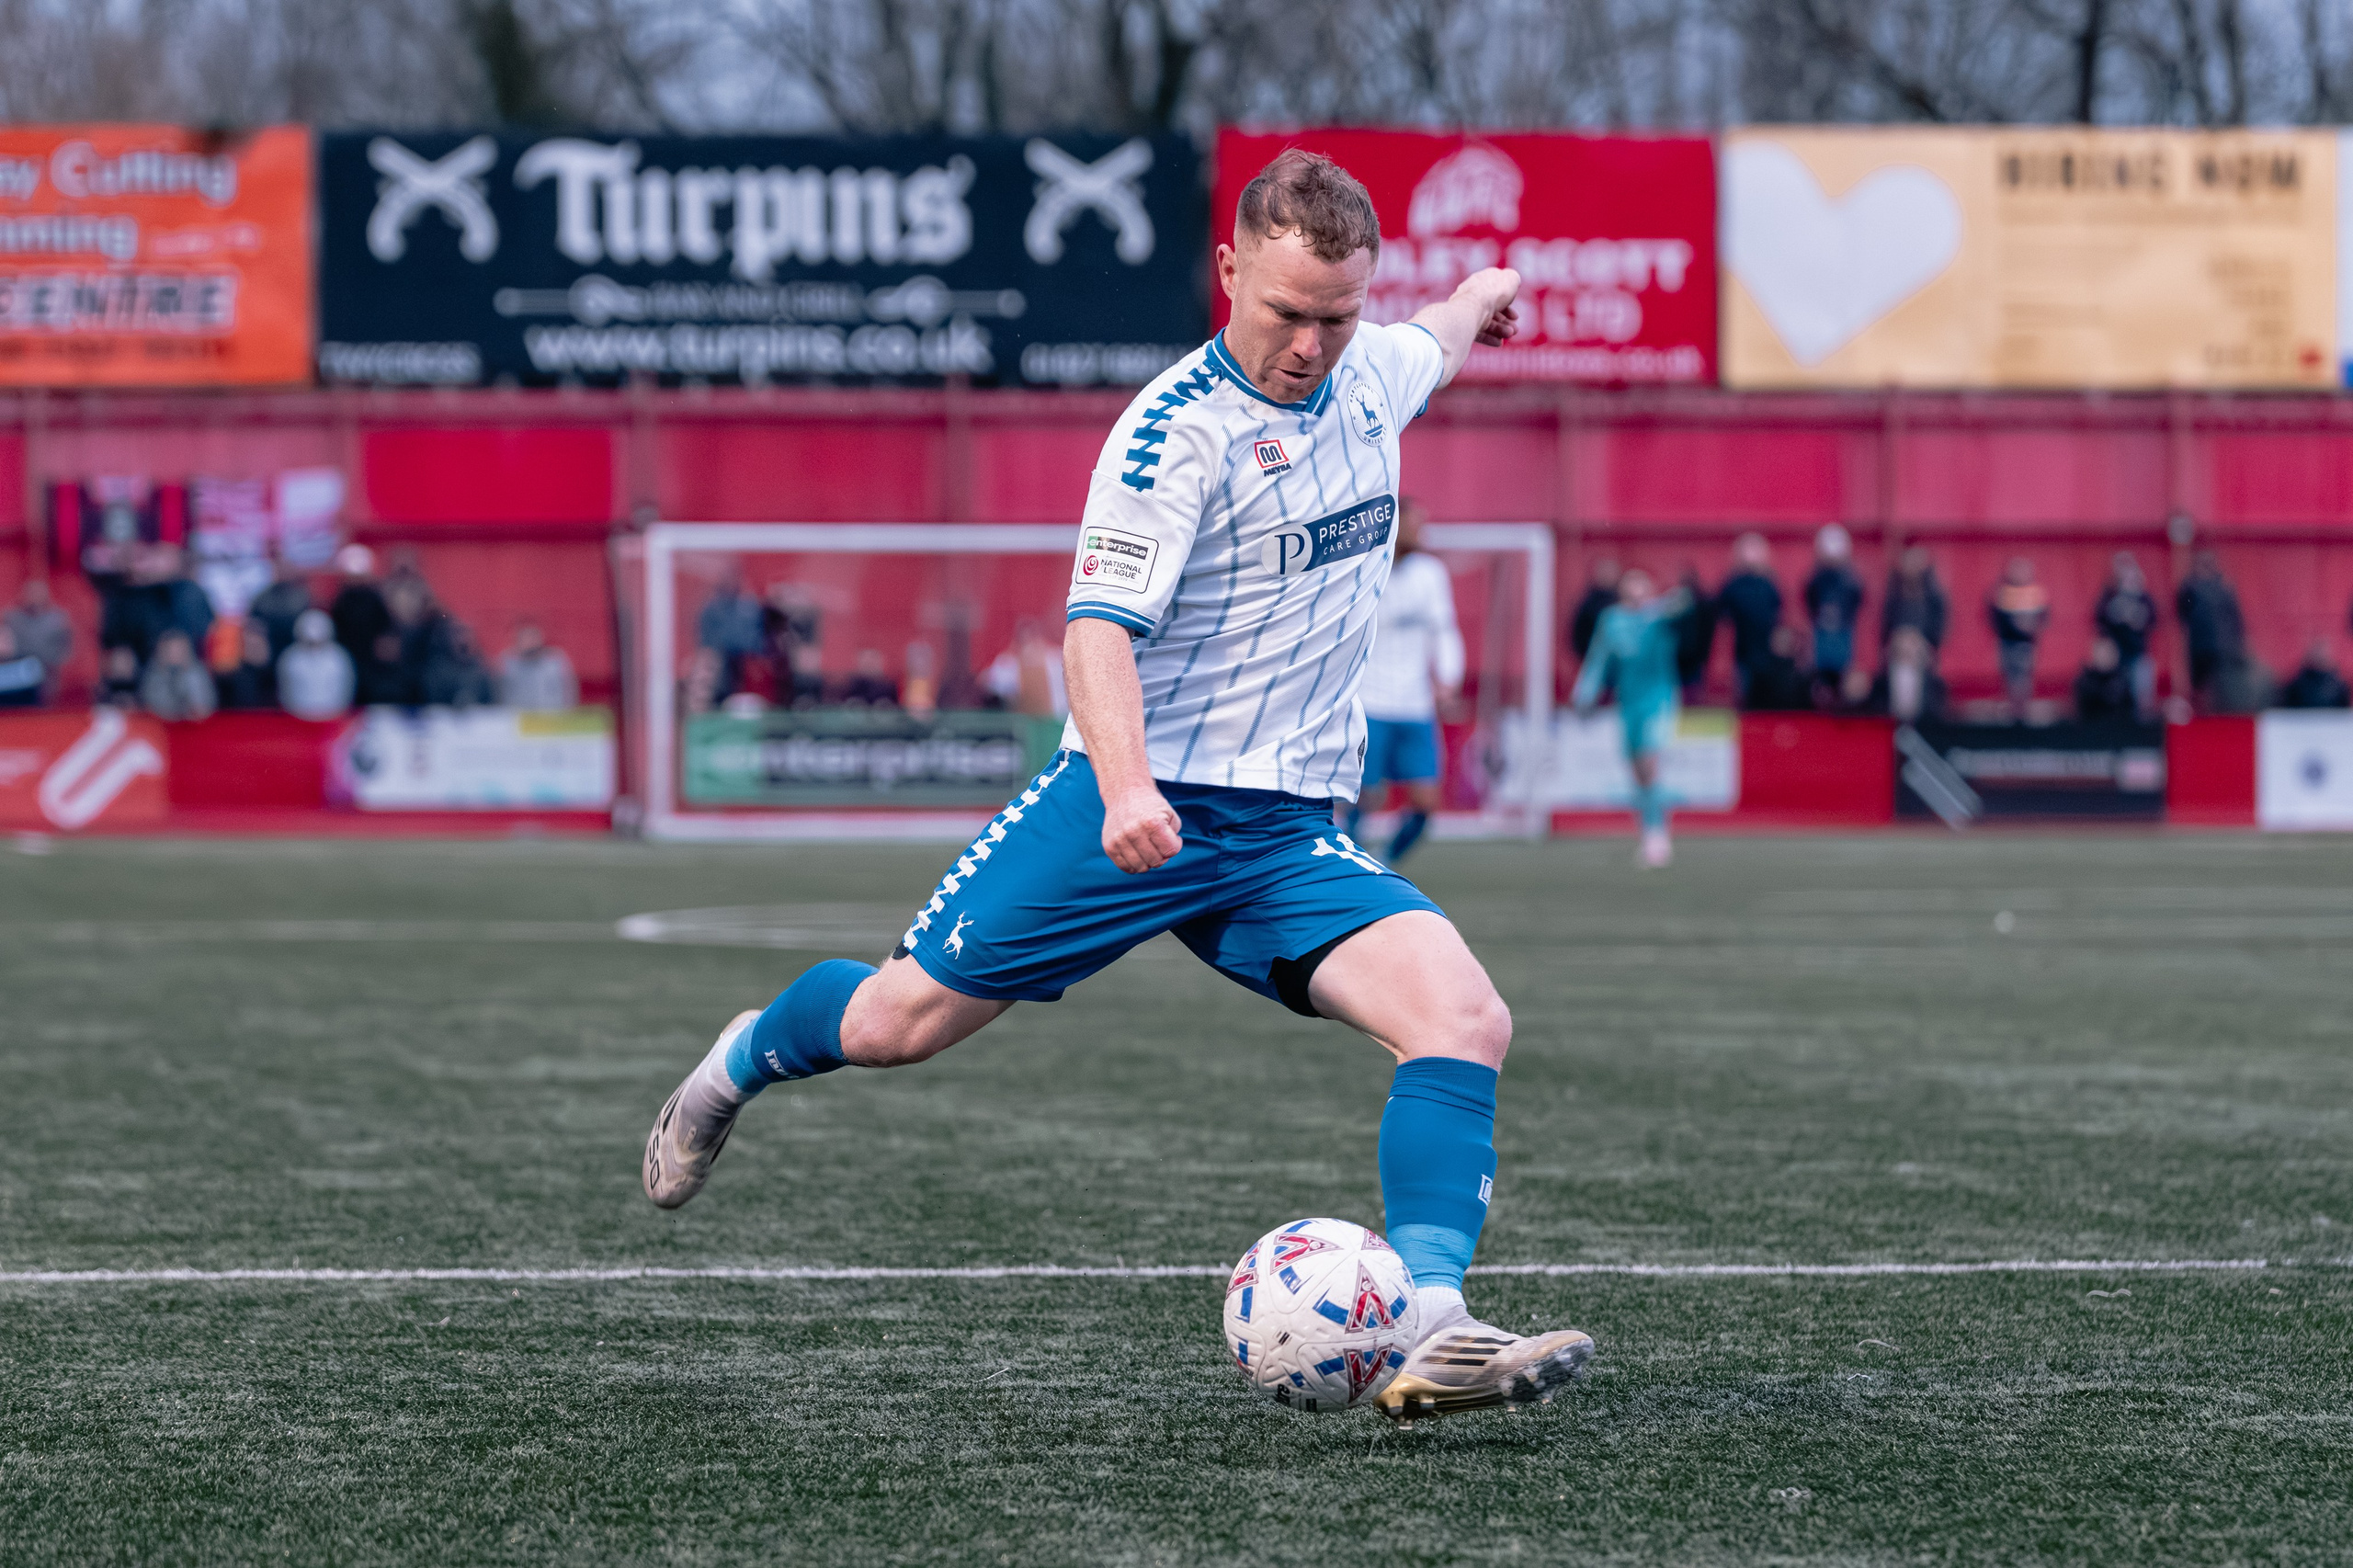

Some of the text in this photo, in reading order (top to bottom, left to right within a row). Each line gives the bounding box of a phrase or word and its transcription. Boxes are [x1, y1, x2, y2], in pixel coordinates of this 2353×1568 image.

[1263, 462, 1292, 477] MEYBA
[1319, 503, 1392, 544] PRESTIGE
[1088, 538, 1147, 557] enterprise
[1324, 526, 1388, 555] CARE GROUP
[1100, 559, 1142, 574] NATIONAL
[1103, 566, 1137, 580] LEAGUE
